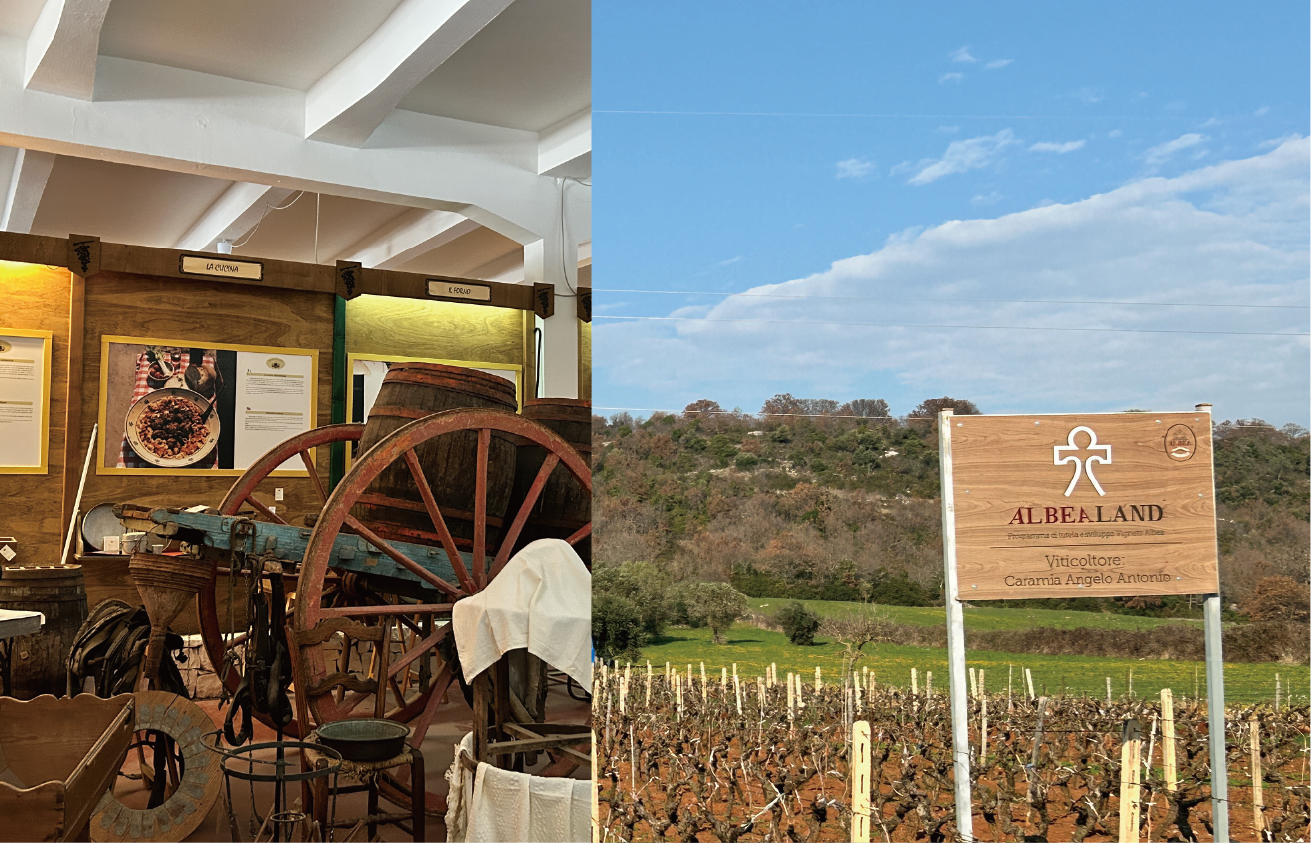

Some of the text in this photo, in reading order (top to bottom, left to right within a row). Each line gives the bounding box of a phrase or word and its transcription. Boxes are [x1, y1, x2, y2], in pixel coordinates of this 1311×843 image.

[206, 263, 239, 273] LA CUCINA
[1008, 504, 1164, 525] ALBEALAND
[1045, 554, 1125, 569] Viticoltore:
[1004, 572, 1171, 588] Caramia Angelo Antonio
